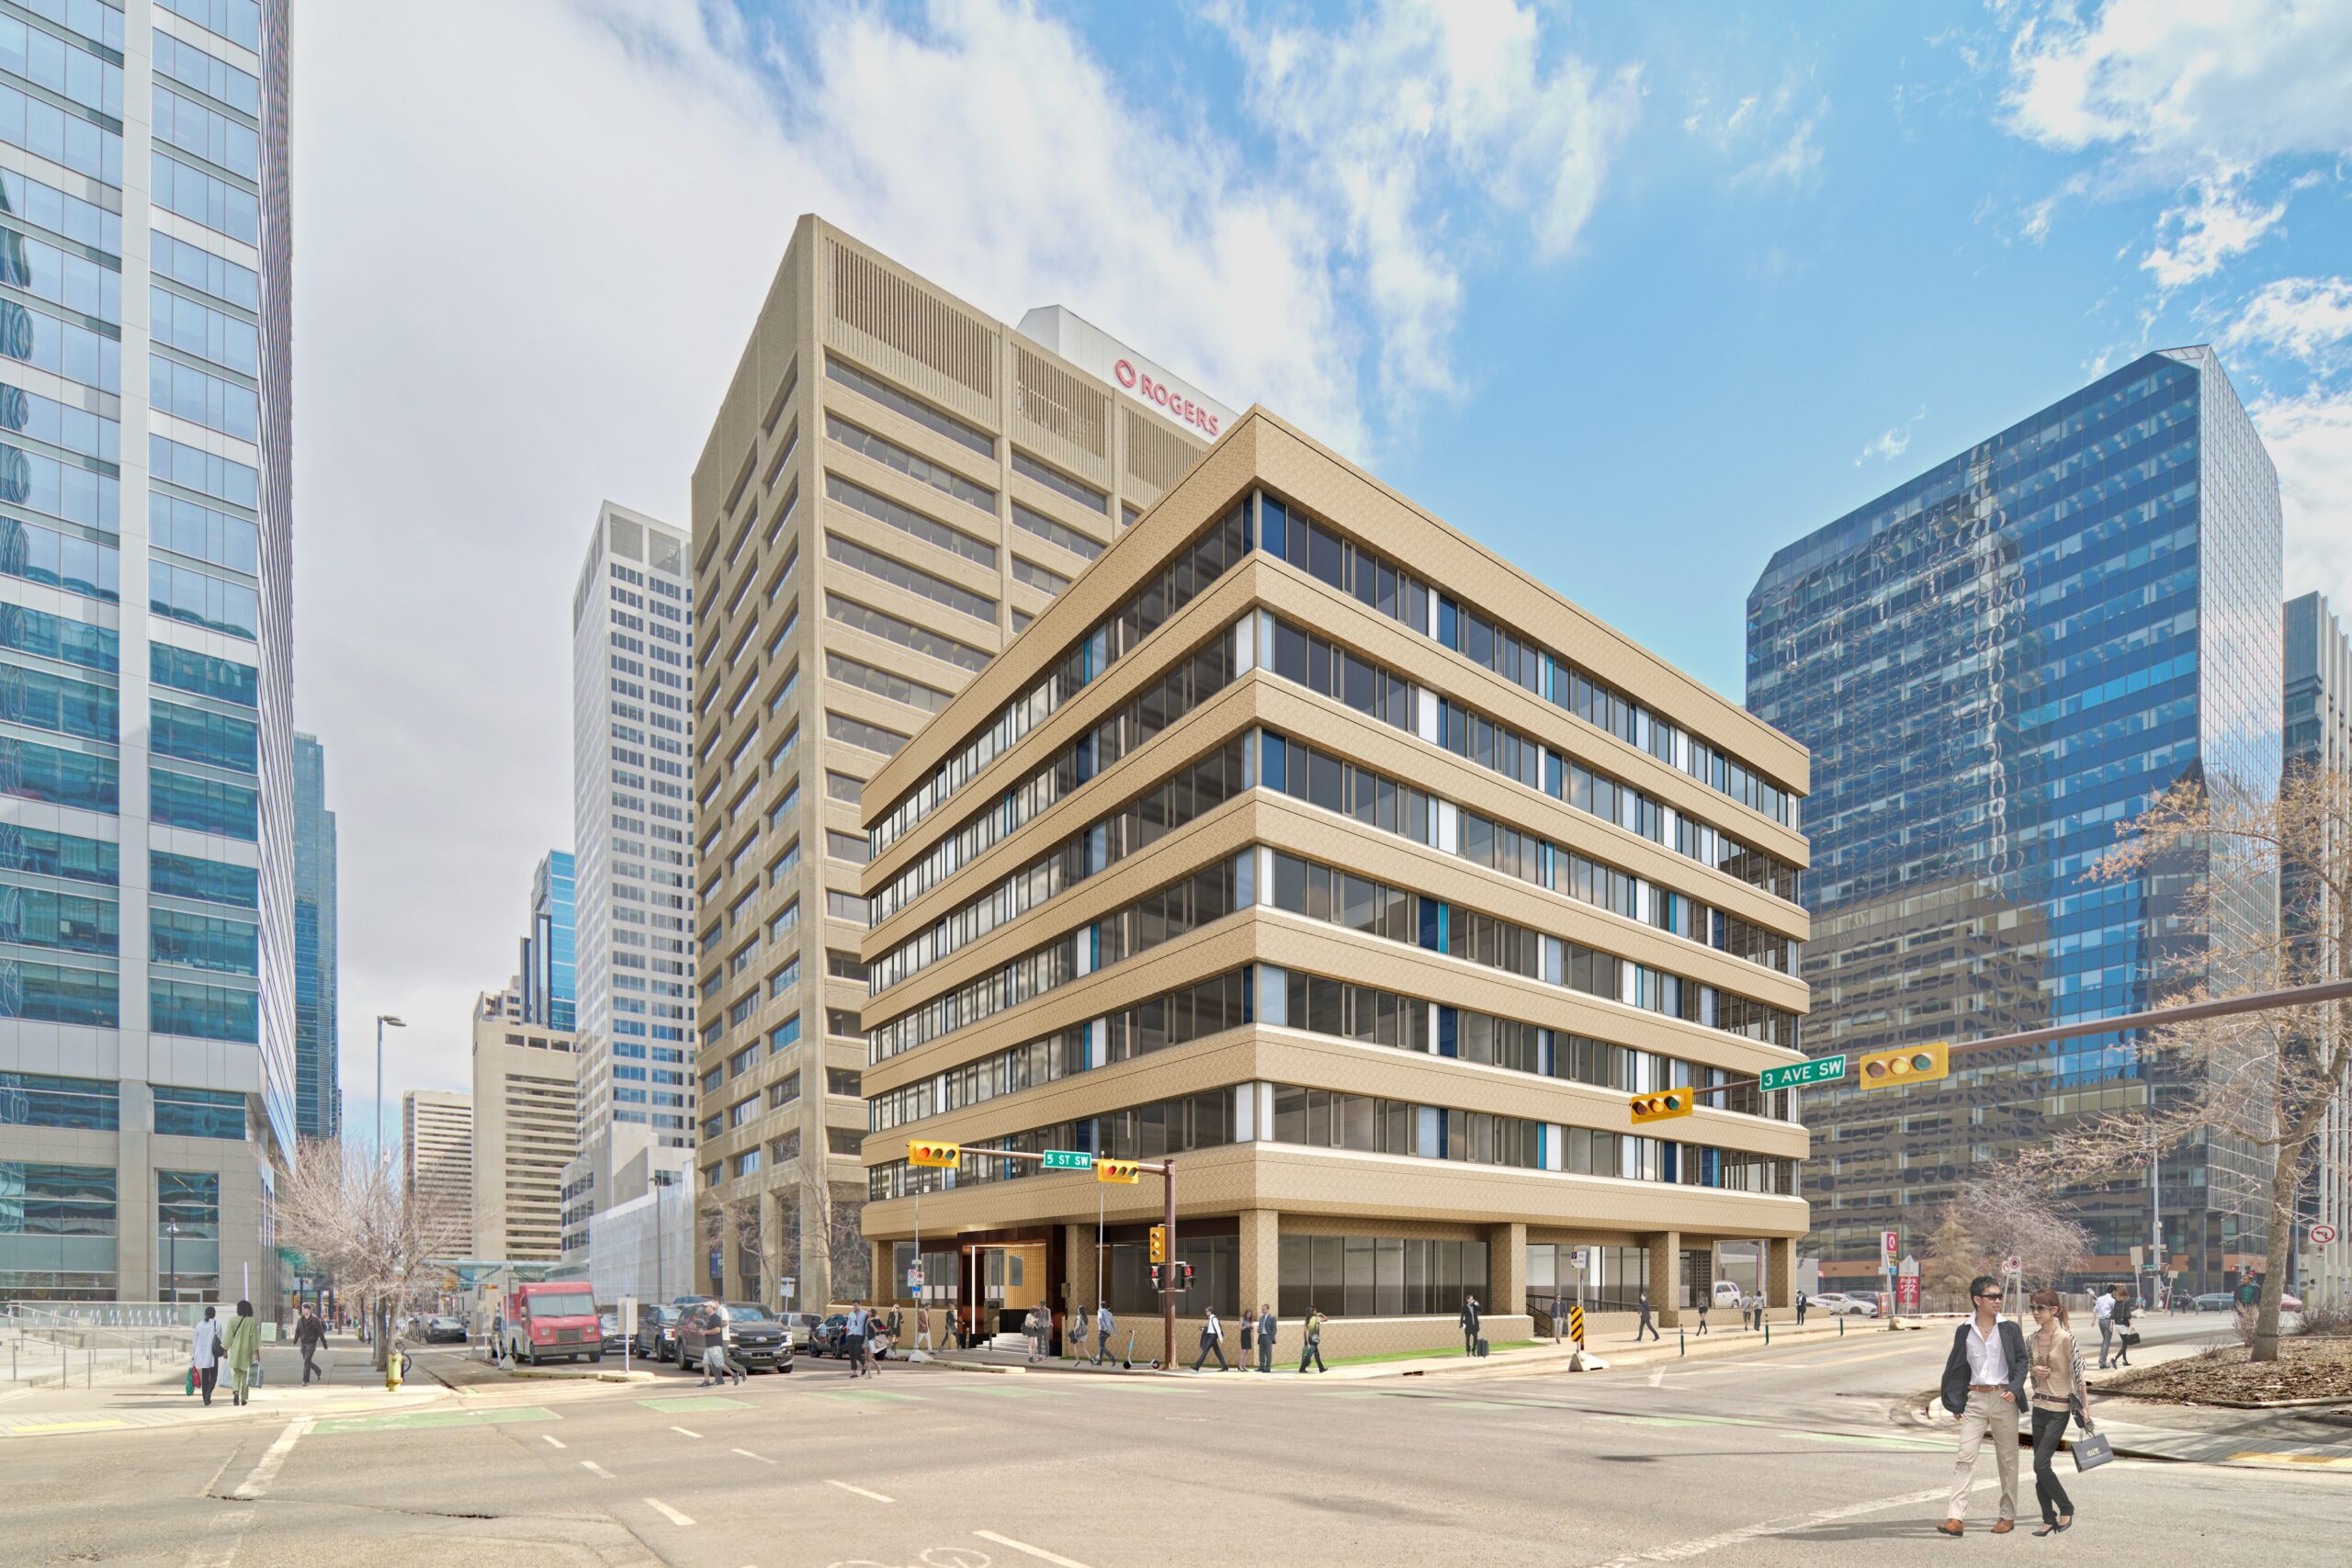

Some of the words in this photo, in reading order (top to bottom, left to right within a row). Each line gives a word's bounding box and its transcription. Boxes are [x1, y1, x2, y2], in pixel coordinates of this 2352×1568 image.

[1141, 374, 1218, 435] ROGERS
[1764, 1073, 1773, 1087] 3
[1781, 1066, 1812, 1083] AVE
[1819, 1060, 1842, 1077] SW
[1046, 1154, 1054, 1165] 5
[1058, 1155, 1070, 1166] ST
[1075, 1156, 1088, 1166] SW
